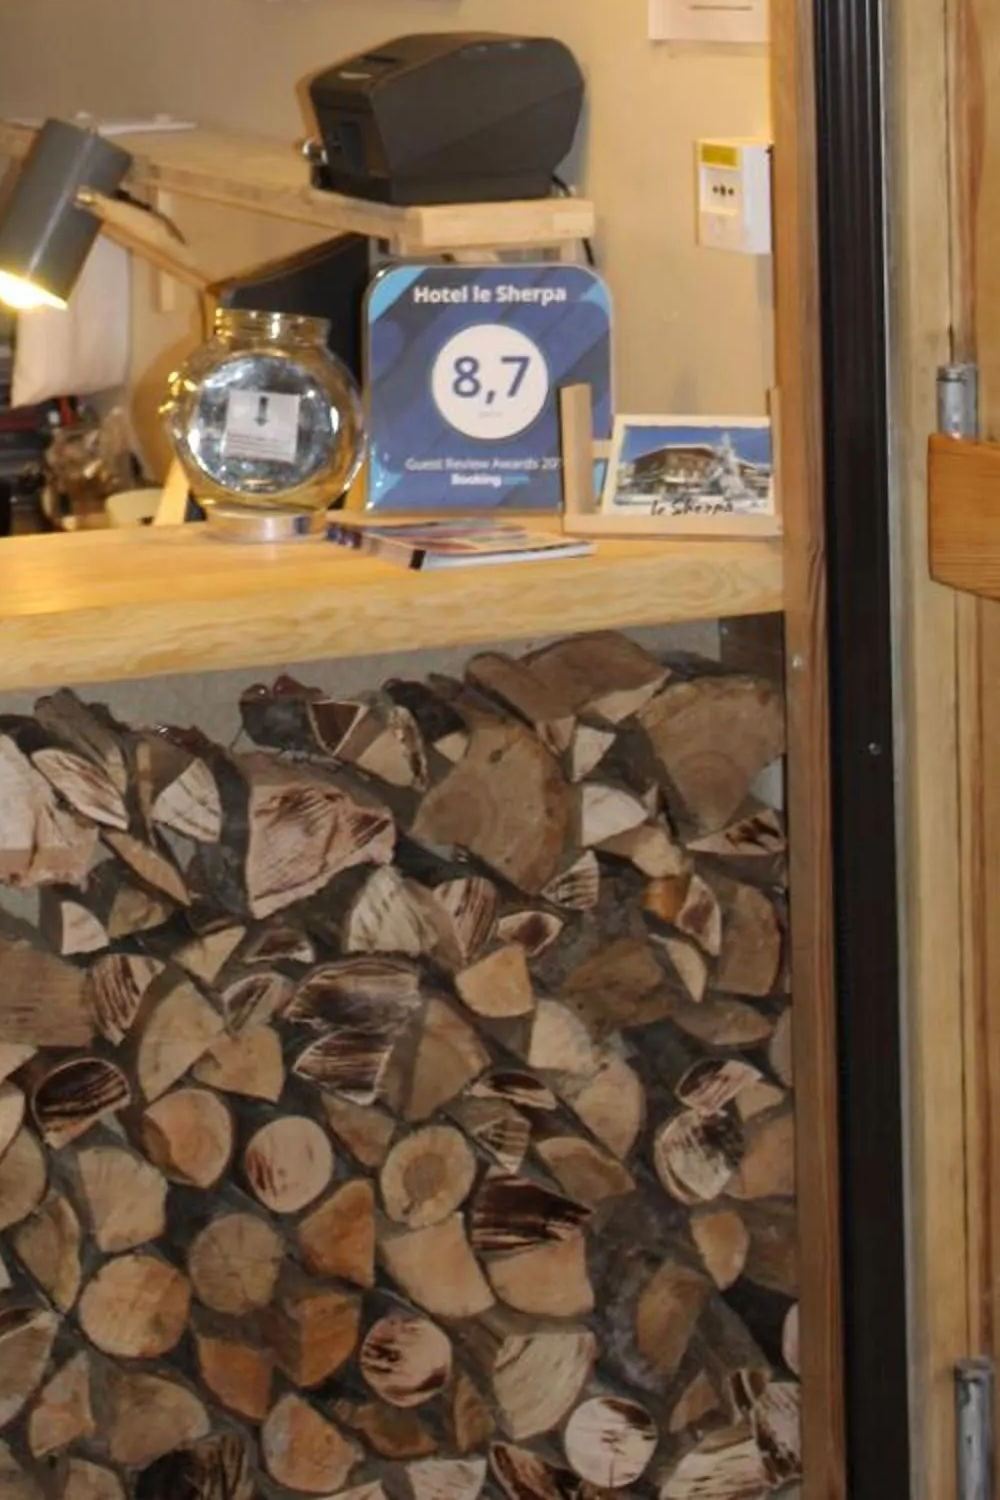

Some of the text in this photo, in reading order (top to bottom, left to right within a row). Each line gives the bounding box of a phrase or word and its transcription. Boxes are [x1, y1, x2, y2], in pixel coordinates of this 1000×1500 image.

[413, 285, 567, 307] Hotel le Sherpa
[452, 355, 531, 405] 8,7
[405, 457, 443, 471] Guest
[446, 457, 489, 471] Review
[492, 456, 539, 470] Awards
